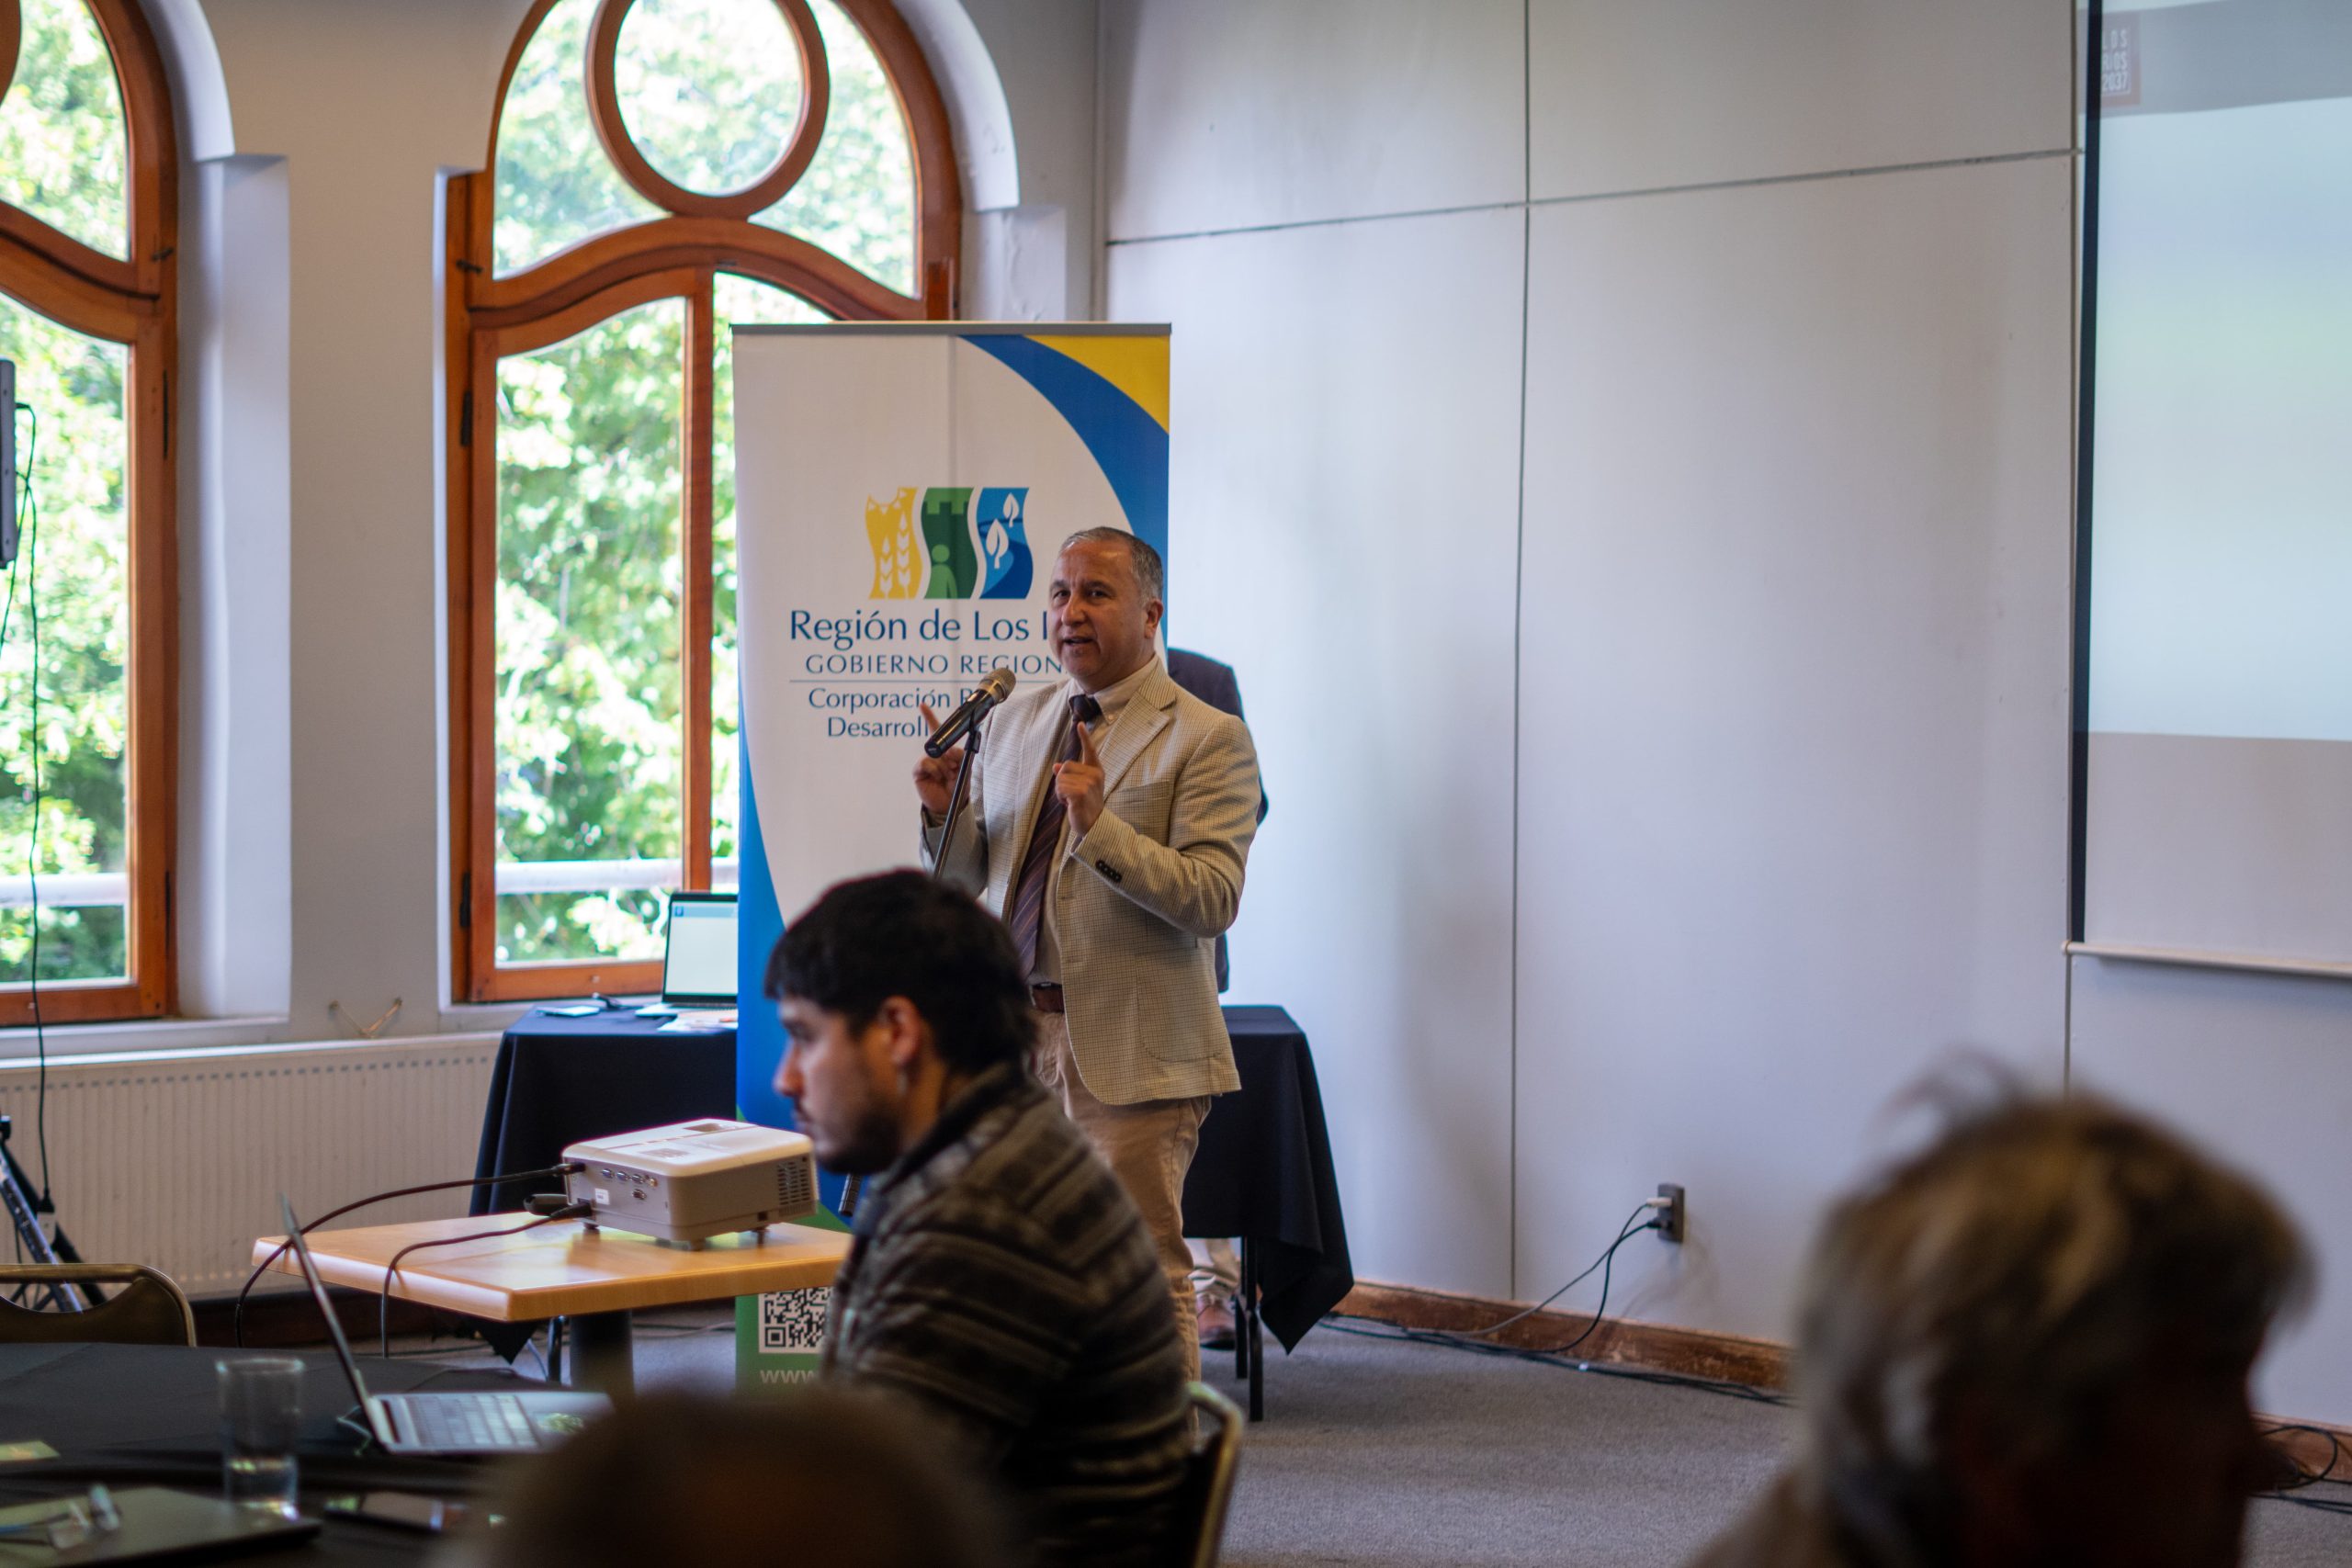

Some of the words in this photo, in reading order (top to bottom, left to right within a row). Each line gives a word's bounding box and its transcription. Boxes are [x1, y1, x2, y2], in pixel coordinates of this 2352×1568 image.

[790, 609, 907, 651] Región
[919, 608, 961, 641] de
[974, 610, 1029, 641] Los
[805, 654, 949, 674] GOBIERNO
[960, 655, 1062, 674] REGION
[808, 687, 950, 714] Corporación
[828, 716, 928, 737] Desarroll
